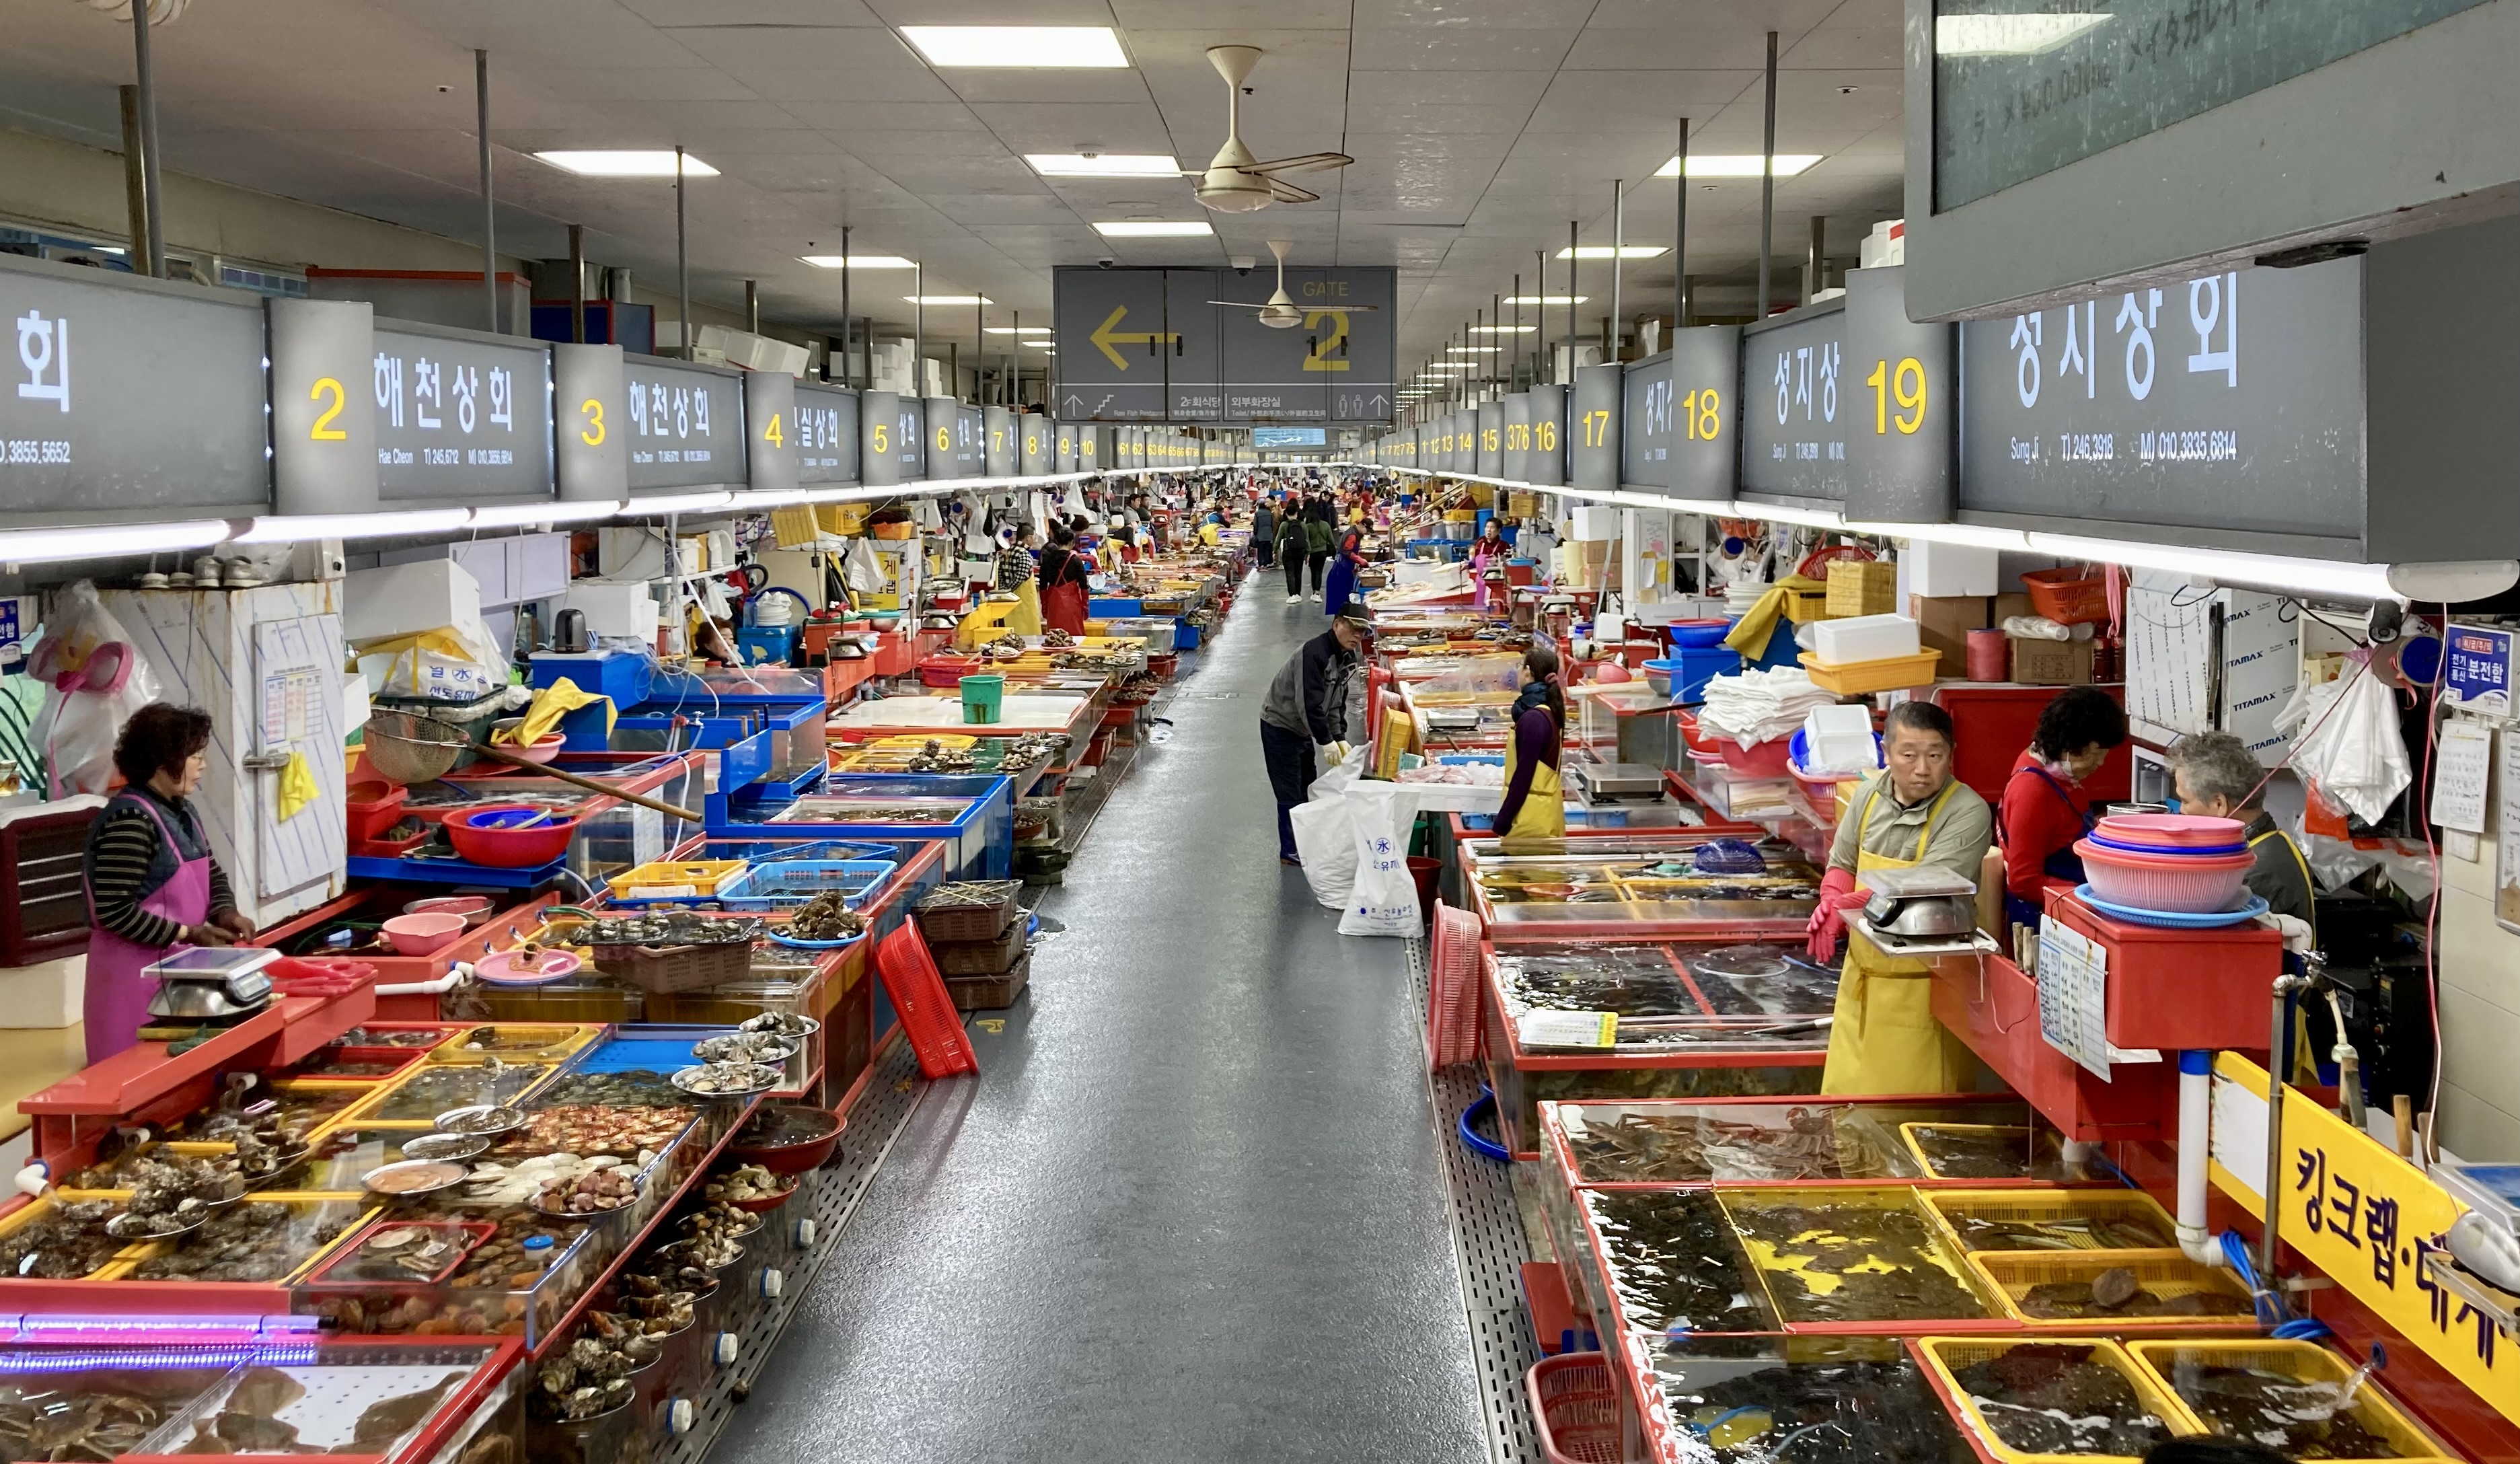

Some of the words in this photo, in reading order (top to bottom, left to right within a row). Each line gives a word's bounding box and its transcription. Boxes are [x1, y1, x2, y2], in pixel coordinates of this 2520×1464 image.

[1303, 281, 1349, 297] GATE
[1302, 311, 1350, 371] 2
[17, 309, 69, 412] 회
[373, 352, 513, 433] 해천상회
[1231, 396, 1281, 408] 외부화장실
[1867, 357, 1927, 435] 19
[309, 377, 346, 440] 2
[630, 381, 710, 438] 해천상회
[1683, 388, 1720, 441] 18
[581, 399, 606, 446] 3
[764, 413, 784, 449] 4
[1583, 411, 1609, 447] 17
[874, 425, 888, 453] 5
[937, 427, 949, 451] 6
[994, 431, 1003, 452] 7
[1028, 436, 1037, 455] 8
[1061, 437, 1070, 454] 9
[1442, 435, 1452, 452] 13
[1458, 433, 1472, 452] 14
[1482, 429, 1497, 452] 15
[1508, 424, 1530, 451] 376
[1535, 421, 1555, 451] 16
[1082, 440, 1094, 456] 10
[1120, 442, 1129, 455] 61
[1132, 443, 1143, 455] 62
[1148, 444, 1157, 456] 63
[1158, 445, 1166, 456] 64
[1168, 445, 1177, 456] 65
[1405, 443, 1415, 455] 75
[2011, 436, 2030, 465] Sung
[2032, 436, 2039, 460] Ji
[2451, 653, 2467, 667] 전기
[2468, 658, 2504, 684] 분전함
[2451, 669, 2466, 682] 통신
[2233, 693, 2276, 711] TITAMAX
